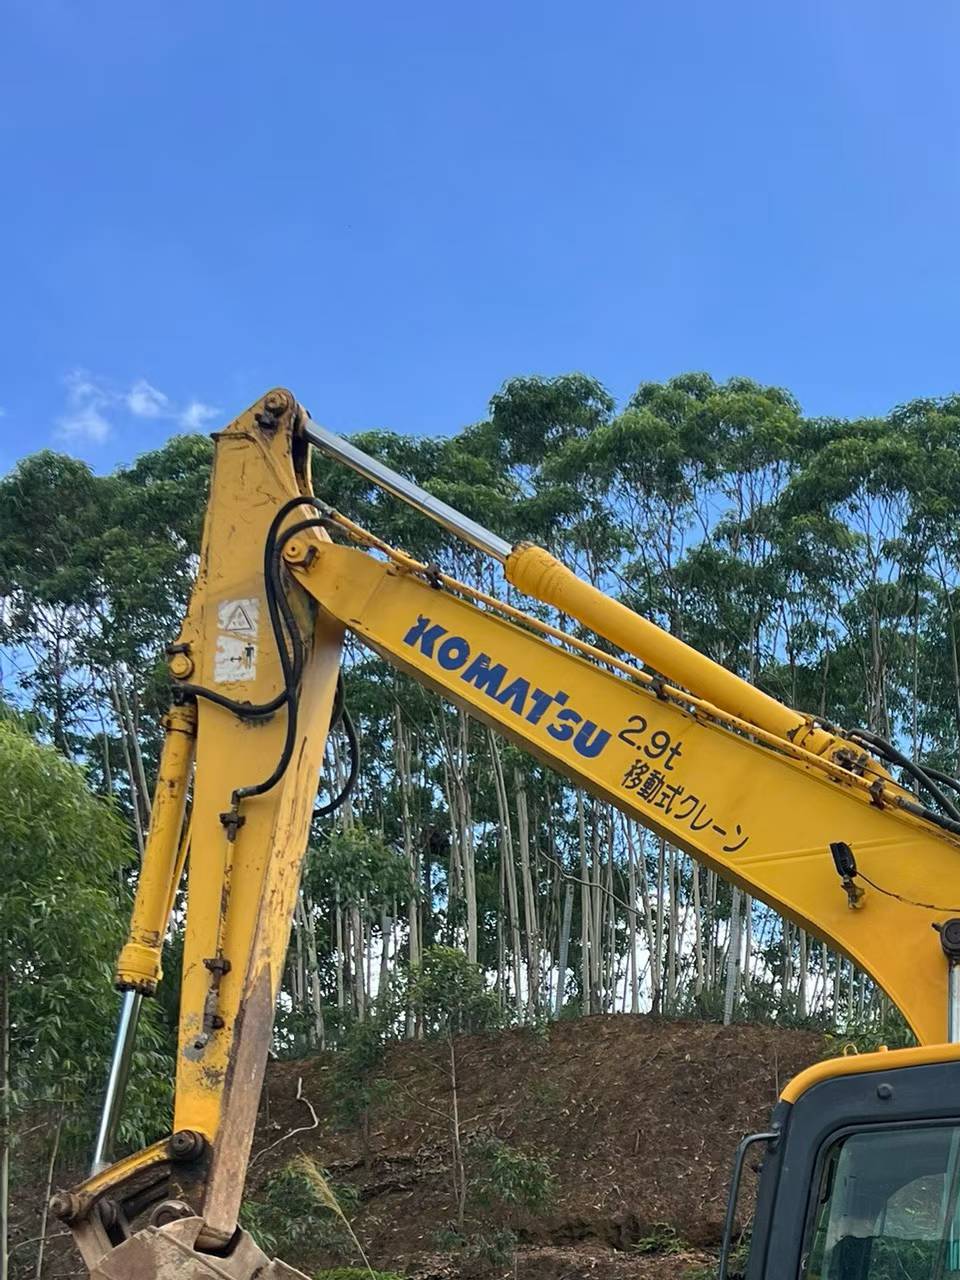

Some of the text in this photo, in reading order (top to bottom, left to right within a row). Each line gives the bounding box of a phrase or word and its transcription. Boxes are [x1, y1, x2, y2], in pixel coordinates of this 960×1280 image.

[402, 613, 612, 759] KOMATSU
[618, 715, 683, 771] 2.9t
[620, 758, 750, 853] 移動式クレーン
